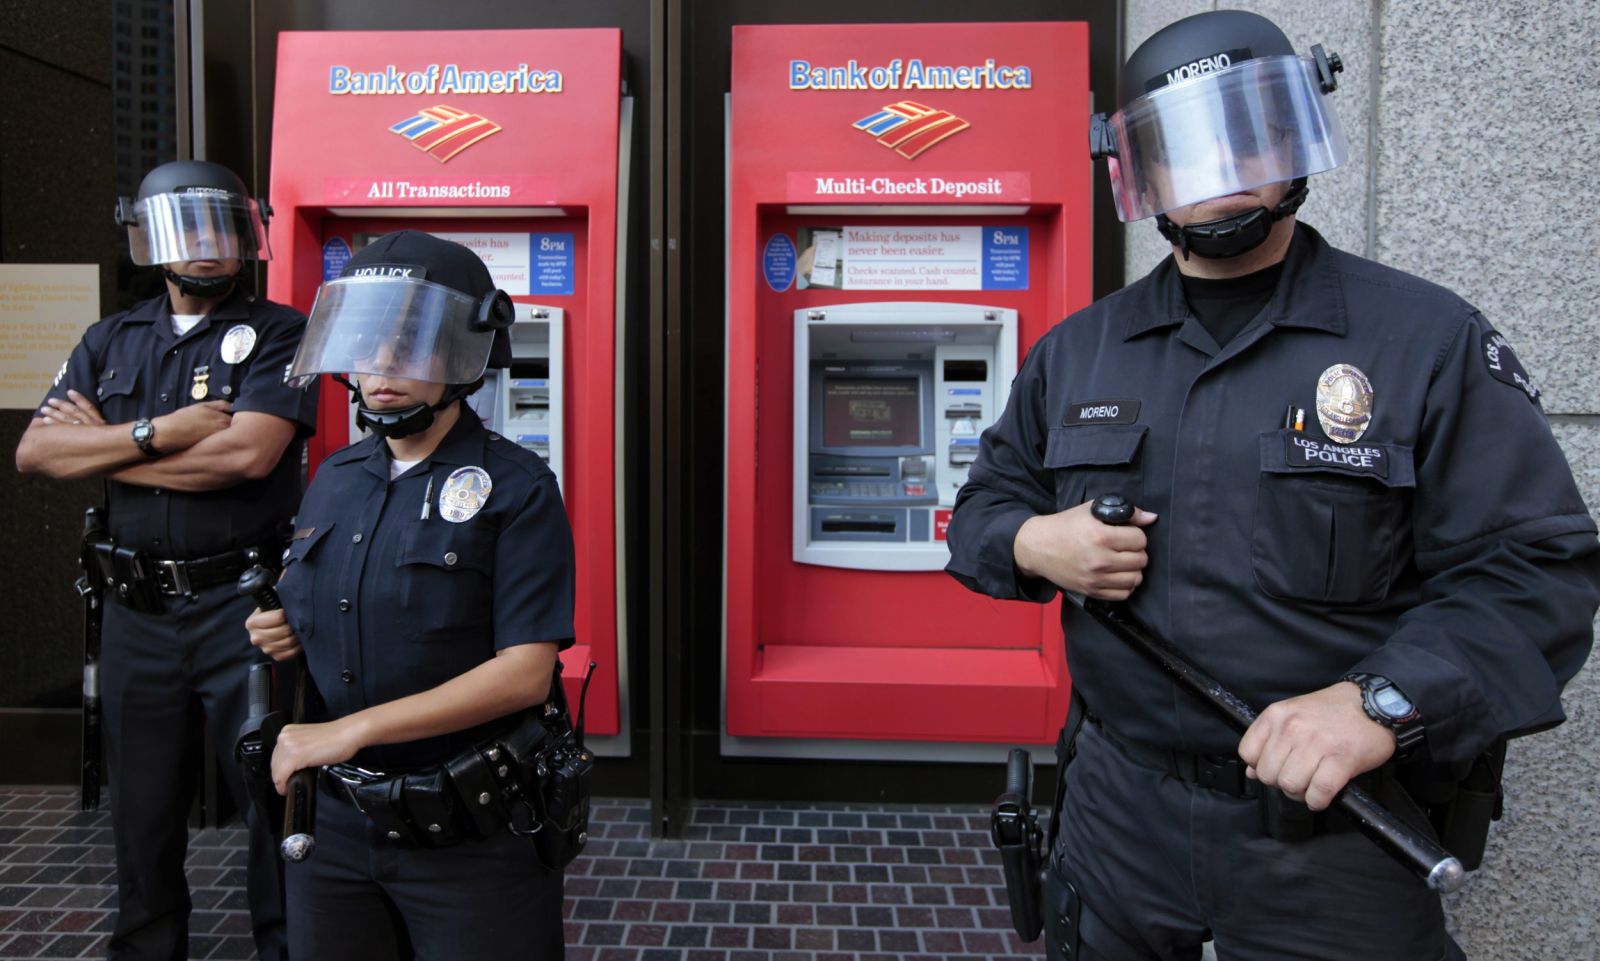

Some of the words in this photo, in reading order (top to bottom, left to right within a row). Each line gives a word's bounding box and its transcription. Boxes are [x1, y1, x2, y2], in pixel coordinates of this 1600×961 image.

[789, 59, 867, 90] Bank
[869, 59, 902, 90] of
[903, 59, 1032, 90] America
[1166, 53, 1231, 85] MORENO
[329, 65, 404, 94] Bank
[406, 64, 439, 94] of
[439, 64, 562, 94] America
[367, 182, 394, 198] All
[396, 181, 511, 198] Transactions
[816, 178, 927, 195] Multi-Check
[930, 178, 1002, 197] Deposit
[490, 238, 509, 249] has
[540, 237, 565, 251] 8PM
[848, 231, 890, 244] Making
[893, 231, 938, 244] deposits
[941, 231, 961, 242] has
[993, 230, 1019, 245] 8PM
[848, 247, 878, 256] never
[881, 245, 906, 256] been
[909, 245, 945, 256] easier.
[354, 266, 412, 279] HOLLICK
[847, 266, 878, 275] Checks
[880, 266, 917, 275] scanned.
[919, 266, 940, 275] Cash
[943, 266, 978, 275] counted.
[847, 277, 891, 285] Assurance
[894, 277, 902, 285] in
[904, 278, 924, 287] your
[926, 277, 950, 285] hand.
[1486, 343, 1502, 371] LOS
[1080, 405, 1119, 419] MORENO
[1293, 437, 1319, 450] LOS
[1323, 443, 1381, 458] ANGELES
[1304, 448, 1374, 467] POLICE
